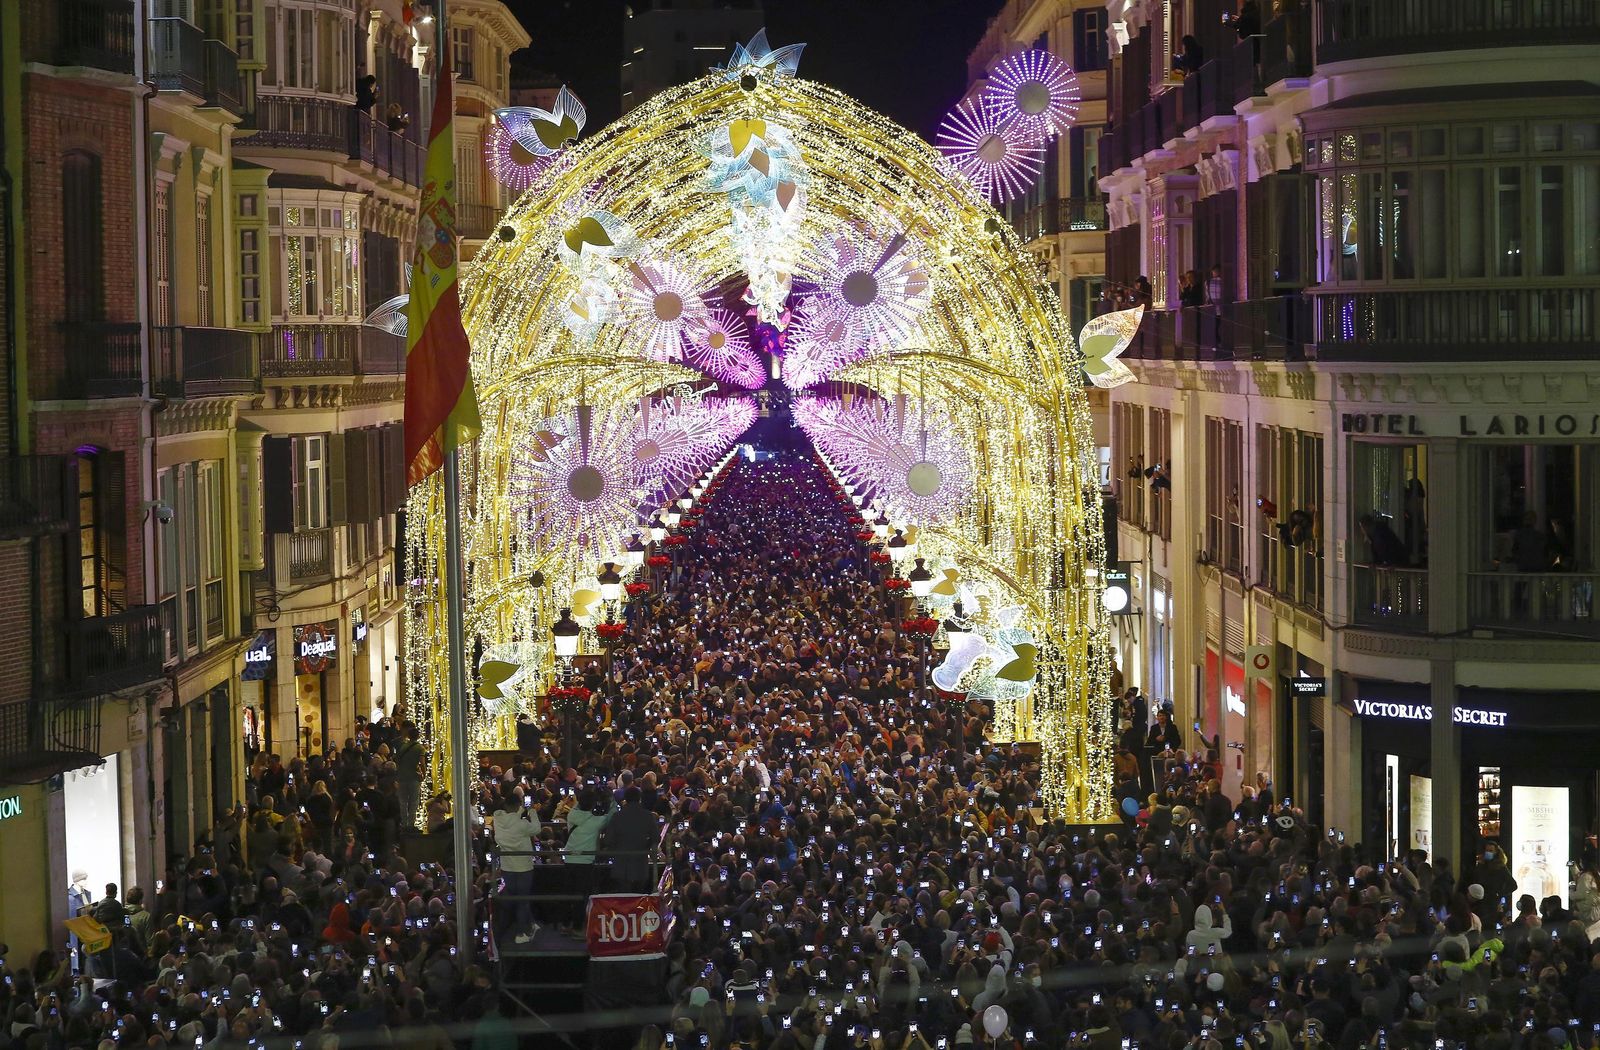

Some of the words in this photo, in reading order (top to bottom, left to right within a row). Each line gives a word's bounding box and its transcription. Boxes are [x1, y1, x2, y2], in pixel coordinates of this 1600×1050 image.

[1342, 414, 1424, 435] HOTEL
[1460, 414, 1600, 435] LARIOS
[1354, 699, 1433, 720] VICTORIA'S
[1454, 706, 1507, 726] SECRET
[597, 913, 641, 943] 101
